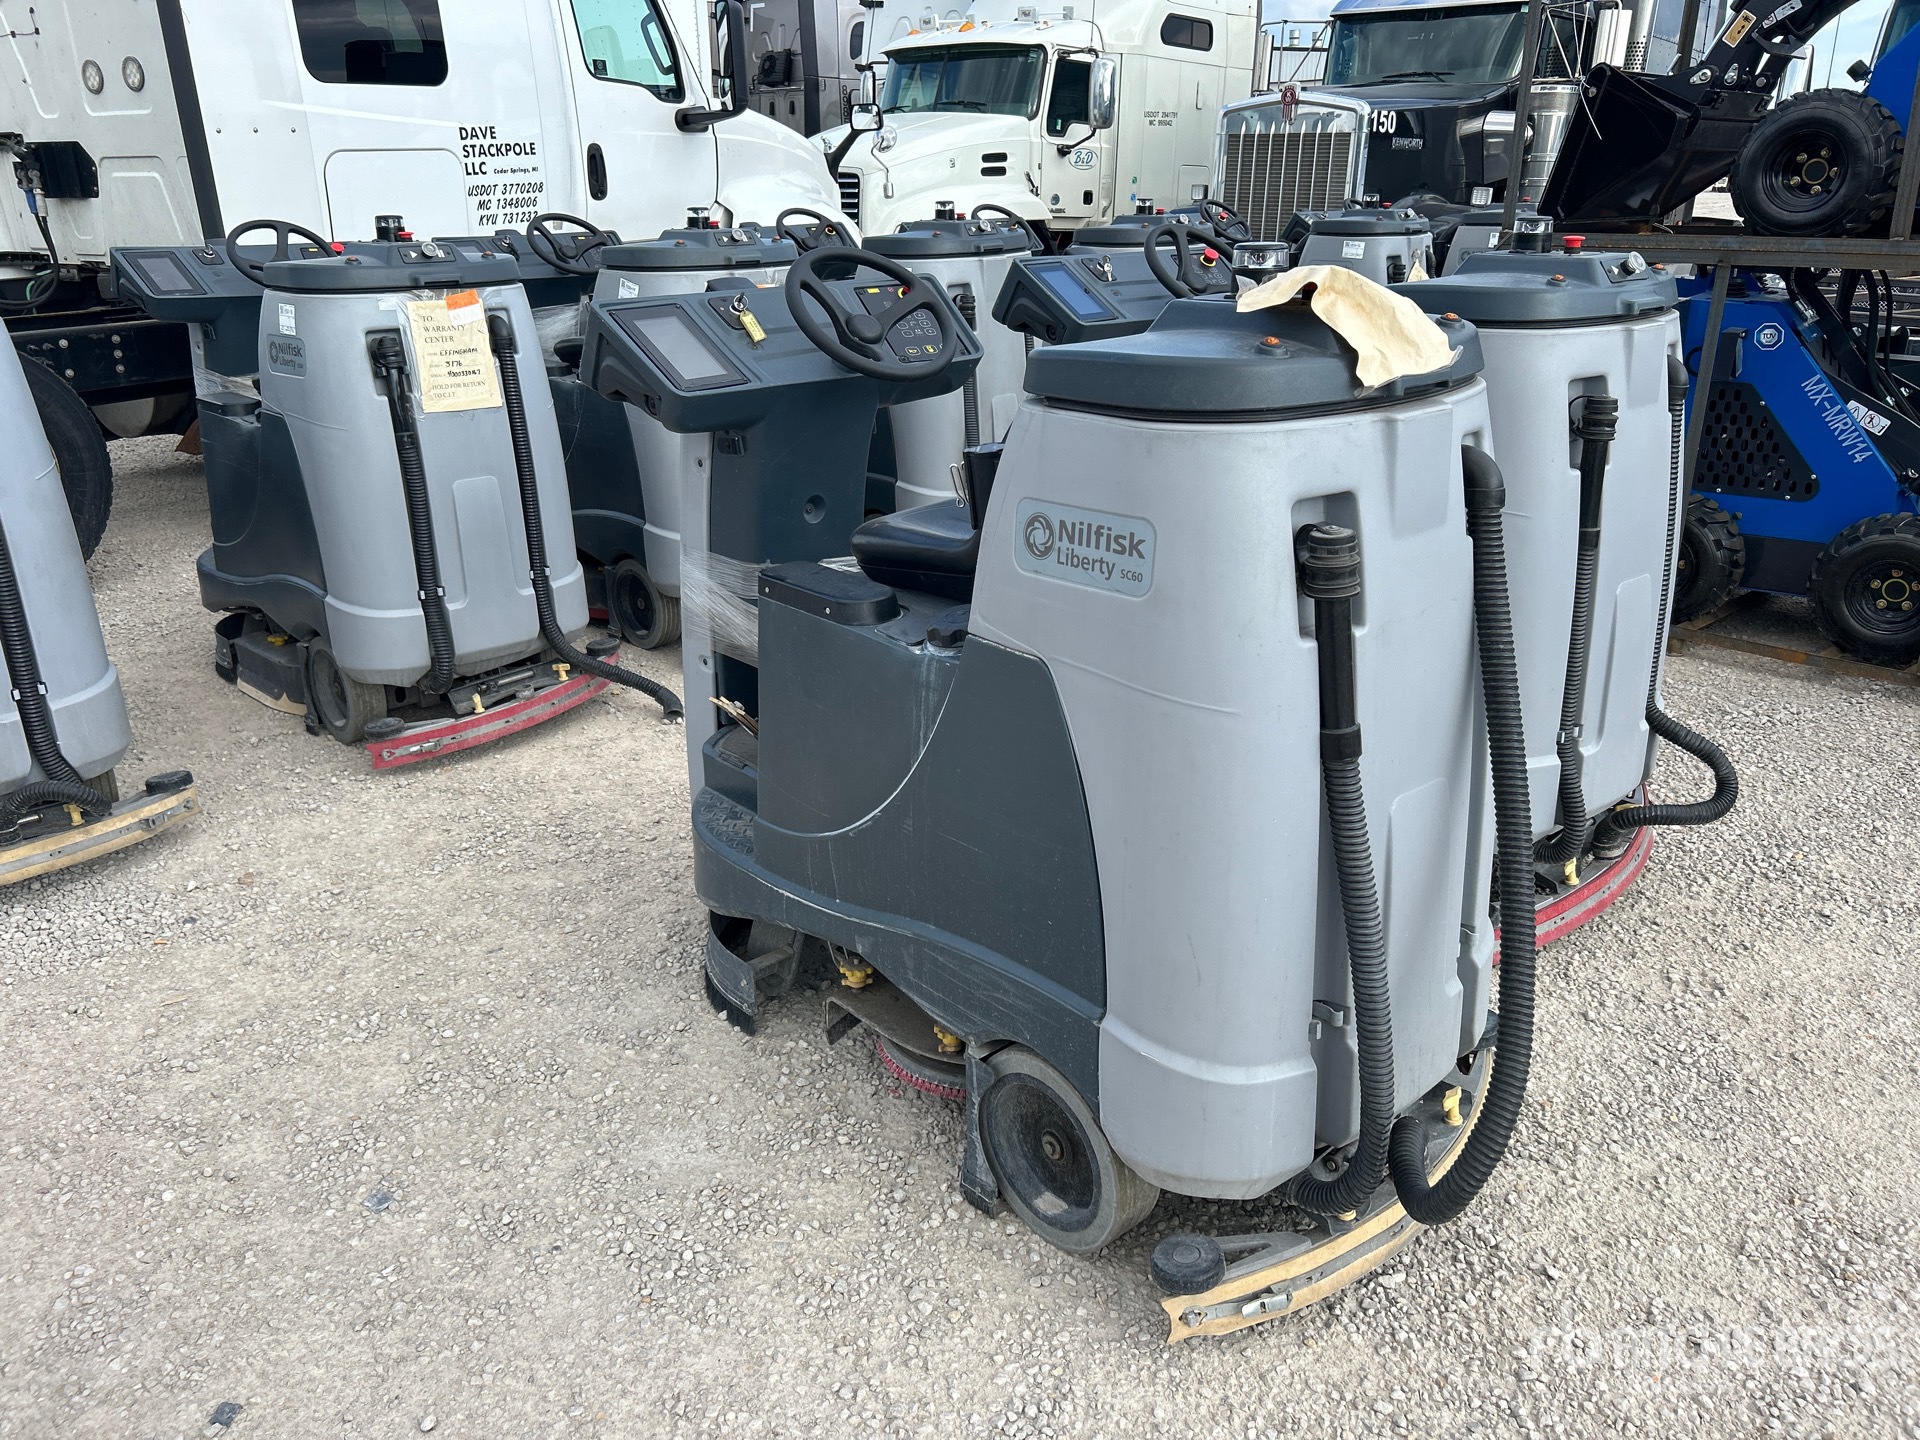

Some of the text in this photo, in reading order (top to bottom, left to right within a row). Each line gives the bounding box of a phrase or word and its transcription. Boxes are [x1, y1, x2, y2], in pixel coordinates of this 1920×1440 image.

[1371, 109, 1396, 134] 150
[458, 125, 497, 140] DAVE
[1391, 136, 1424, 149] KENWORTH
[462, 142, 537, 159] STACKPOLE
[464, 161, 488, 176] LLC
[467, 181, 544, 197] USDOT 3770208
[476, 196, 538, 211] MC 1348006
[478, 213, 499, 227] KYU
[422, 323, 466, 333] WARRANTY
[424, 335, 455, 344] CENTER
[277, 342, 303, 358] Nilfisk
[439, 347, 478, 357] EFFINGHAM
[279, 356, 297, 370] Liberty
[432, 383, 450, 391] HOLD
[462, 380, 486, 388] RETURN
[1800, 373, 1874, 464] MX-MRW14
[1057, 519, 1147, 560] Nilfisk
[1056, 546, 1143, 583] Liberty SC60
